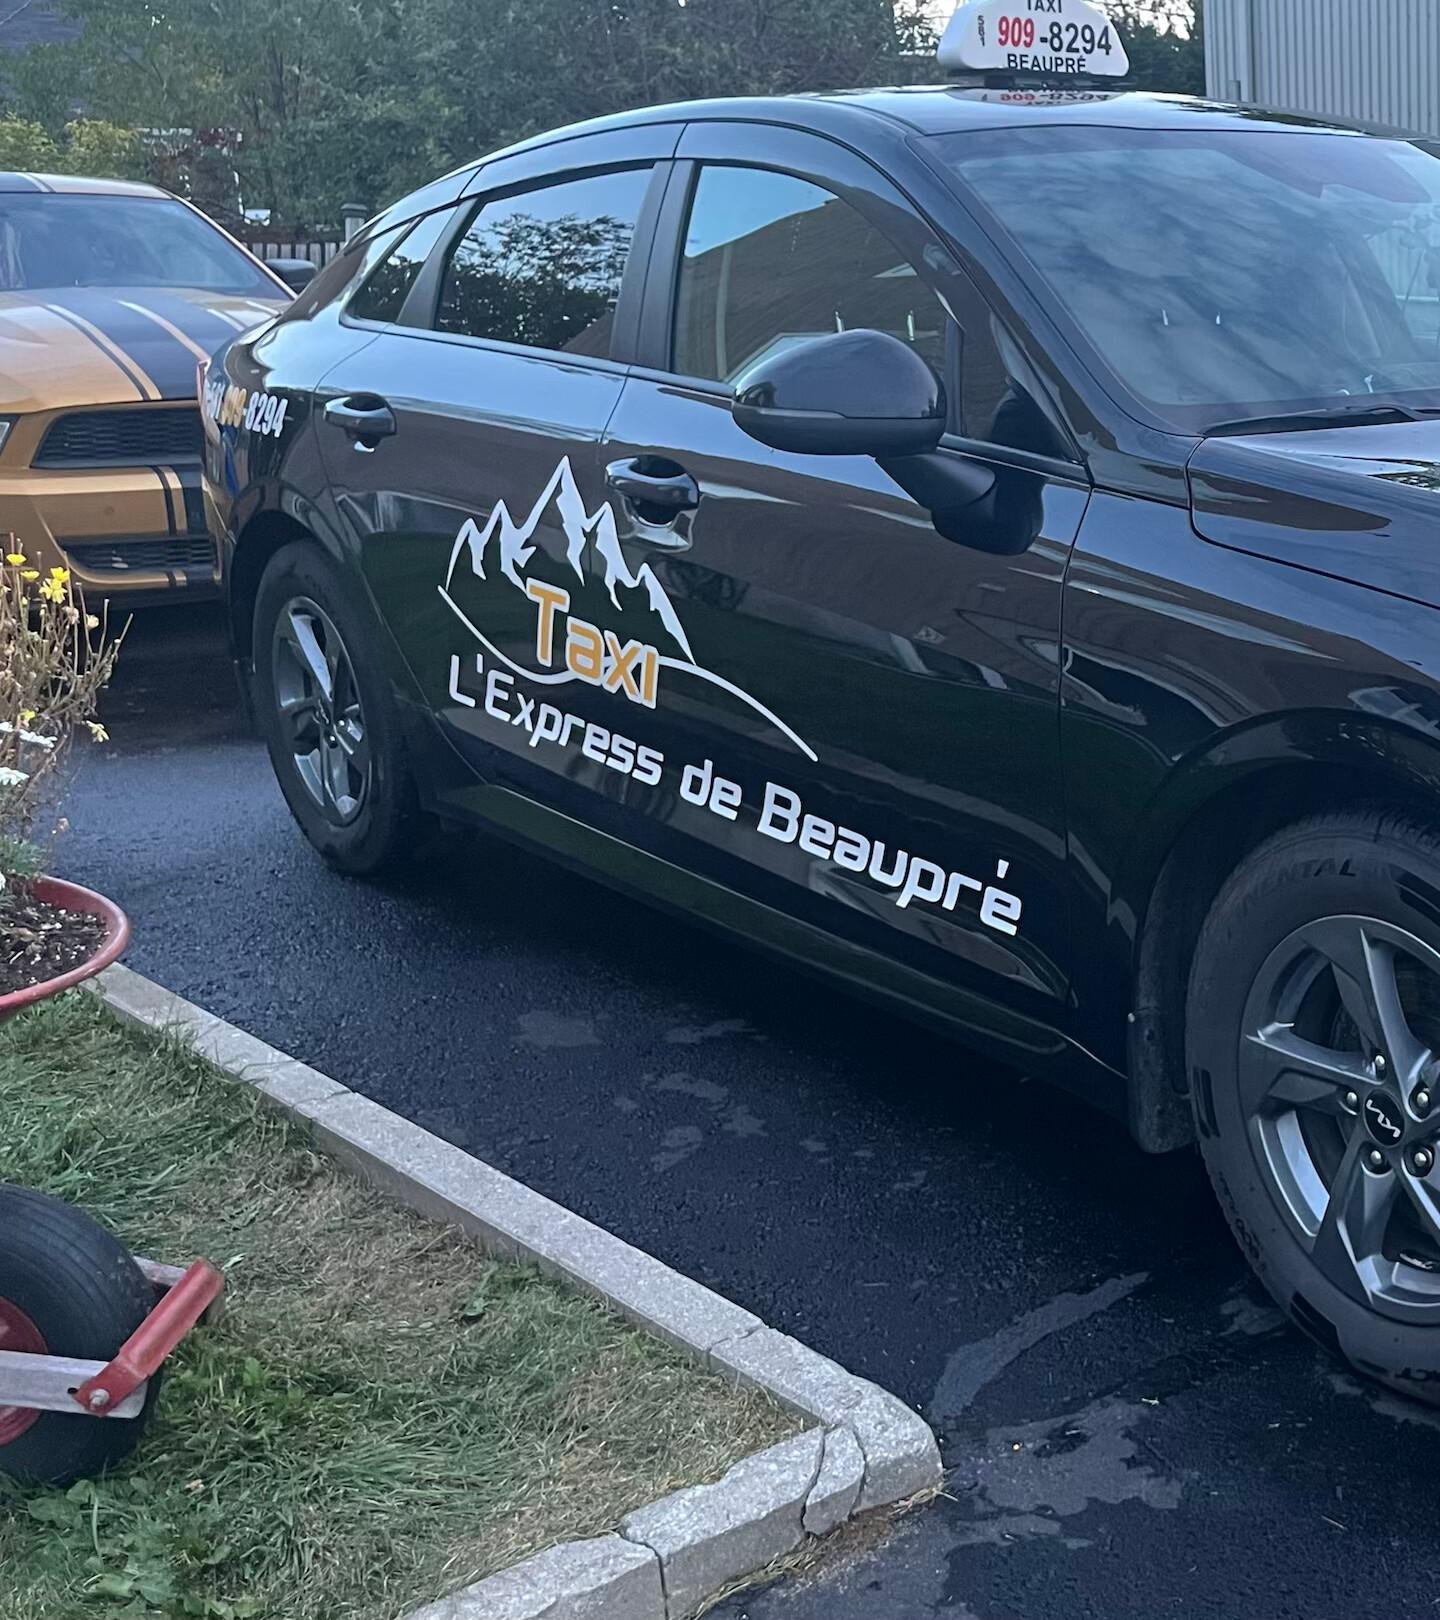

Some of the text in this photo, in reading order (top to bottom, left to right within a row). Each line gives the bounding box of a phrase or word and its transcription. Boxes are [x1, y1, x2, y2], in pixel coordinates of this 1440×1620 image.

[1027, 0, 1063, 13] TAXI
[1007, 54, 1086, 74] BEAUPRÉ
[449, 654, 1023, 936] L'Express de Beaupré
